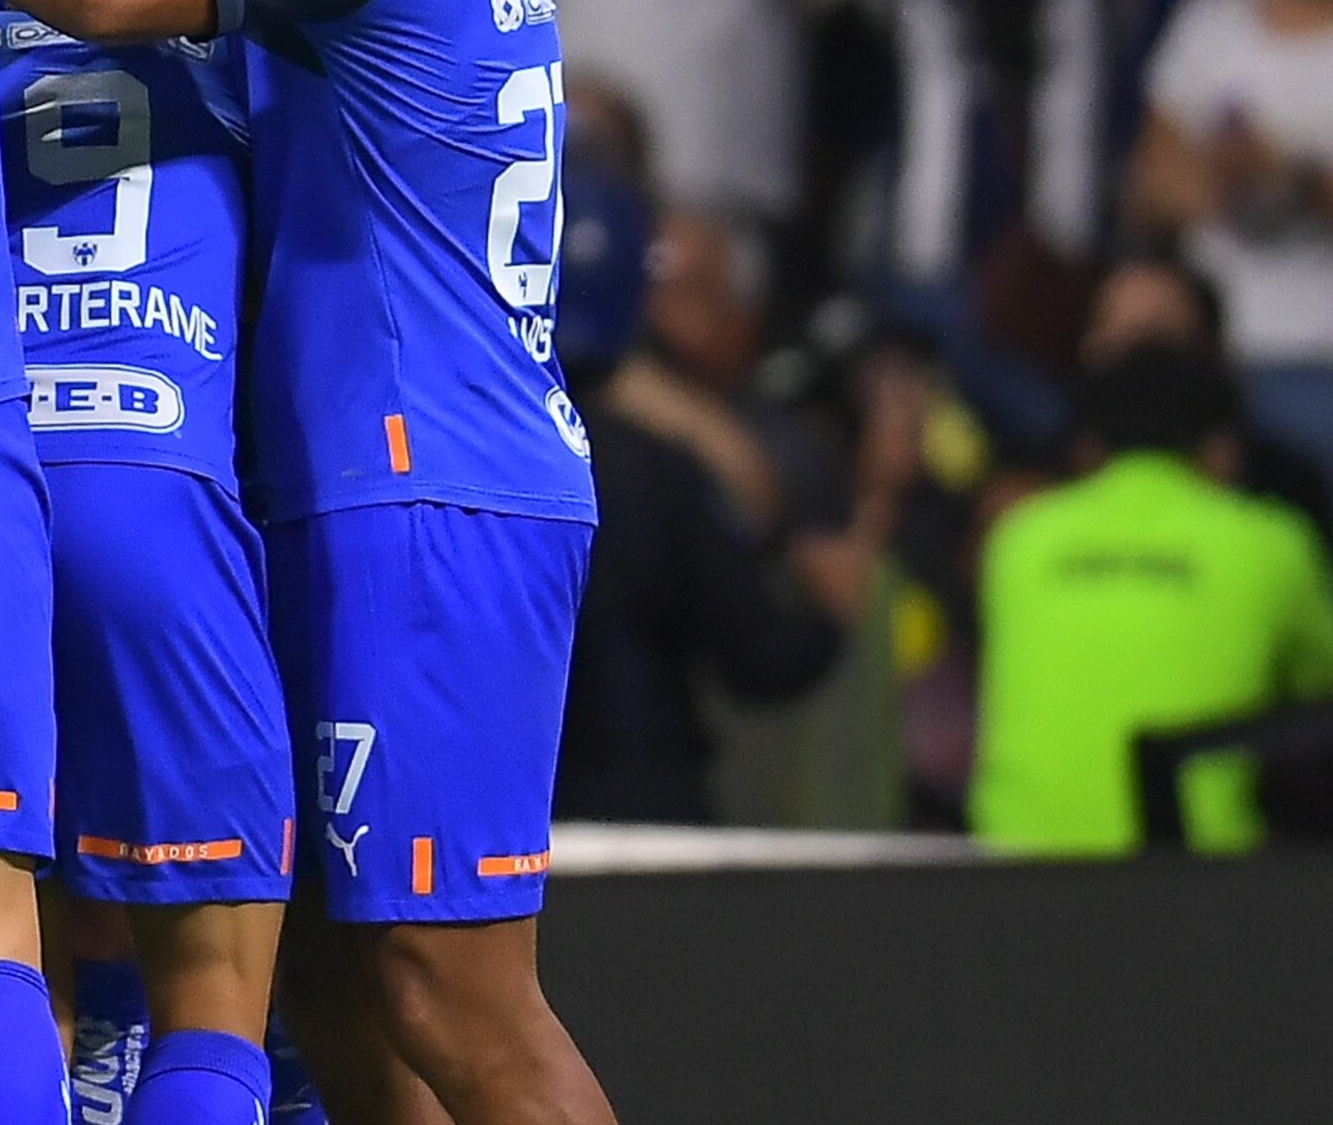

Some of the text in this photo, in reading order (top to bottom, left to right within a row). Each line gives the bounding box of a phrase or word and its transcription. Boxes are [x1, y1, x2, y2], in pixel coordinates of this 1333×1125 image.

[22, 70, 153, 275] 9
[18, 280, 223, 361] RTERAME
[30, 381, 160, 415] -E-B
[316, 722, 376, 814] 27
